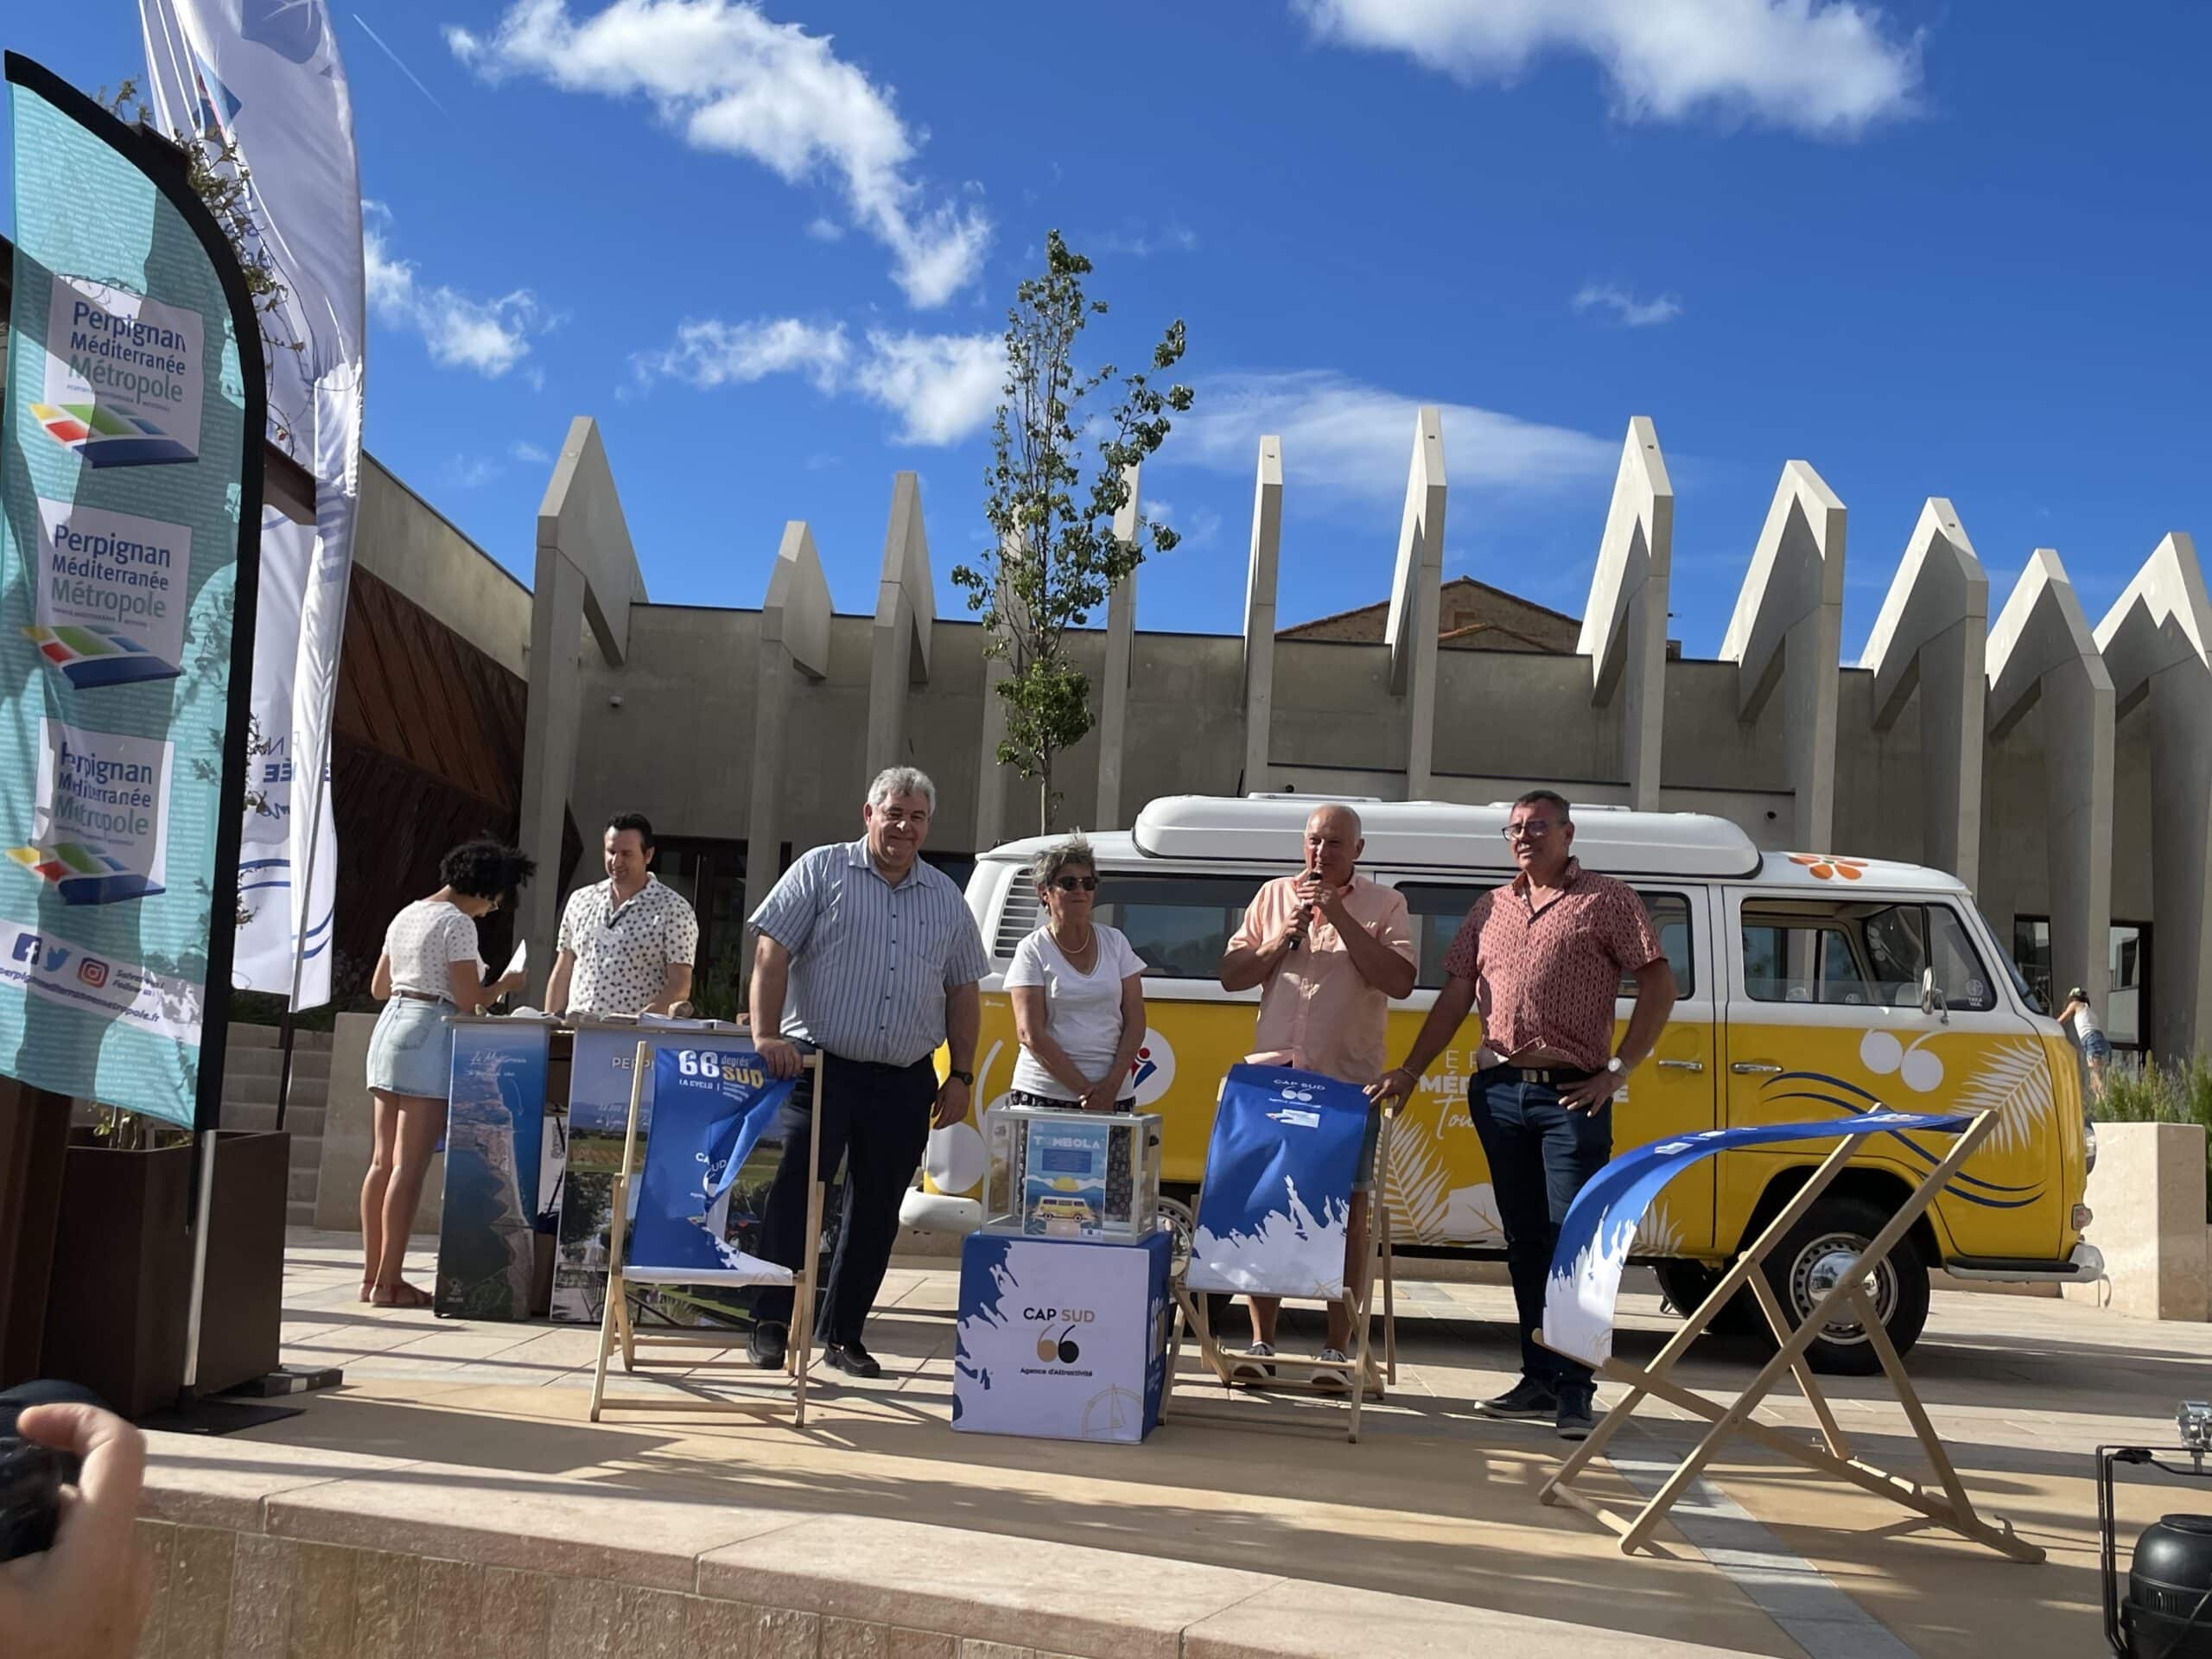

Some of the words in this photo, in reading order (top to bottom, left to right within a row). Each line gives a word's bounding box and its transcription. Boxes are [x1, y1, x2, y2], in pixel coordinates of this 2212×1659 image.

[73, 300, 188, 353] Perpignan
[70, 330, 187, 376] Méditerranée
[67, 353, 184, 405] Métropole
[54, 523, 172, 569] Perpignan
[51, 553, 170, 592] Méditerranée
[50, 576, 167, 623] Métropole
[678, 1049, 720, 1078] 66
[721, 1053, 749, 1067] degrés
[721, 1065, 764, 1089] SUD
[1023, 1306, 1057, 1320] CAP
[1061, 1308, 1096, 1323] SUD
